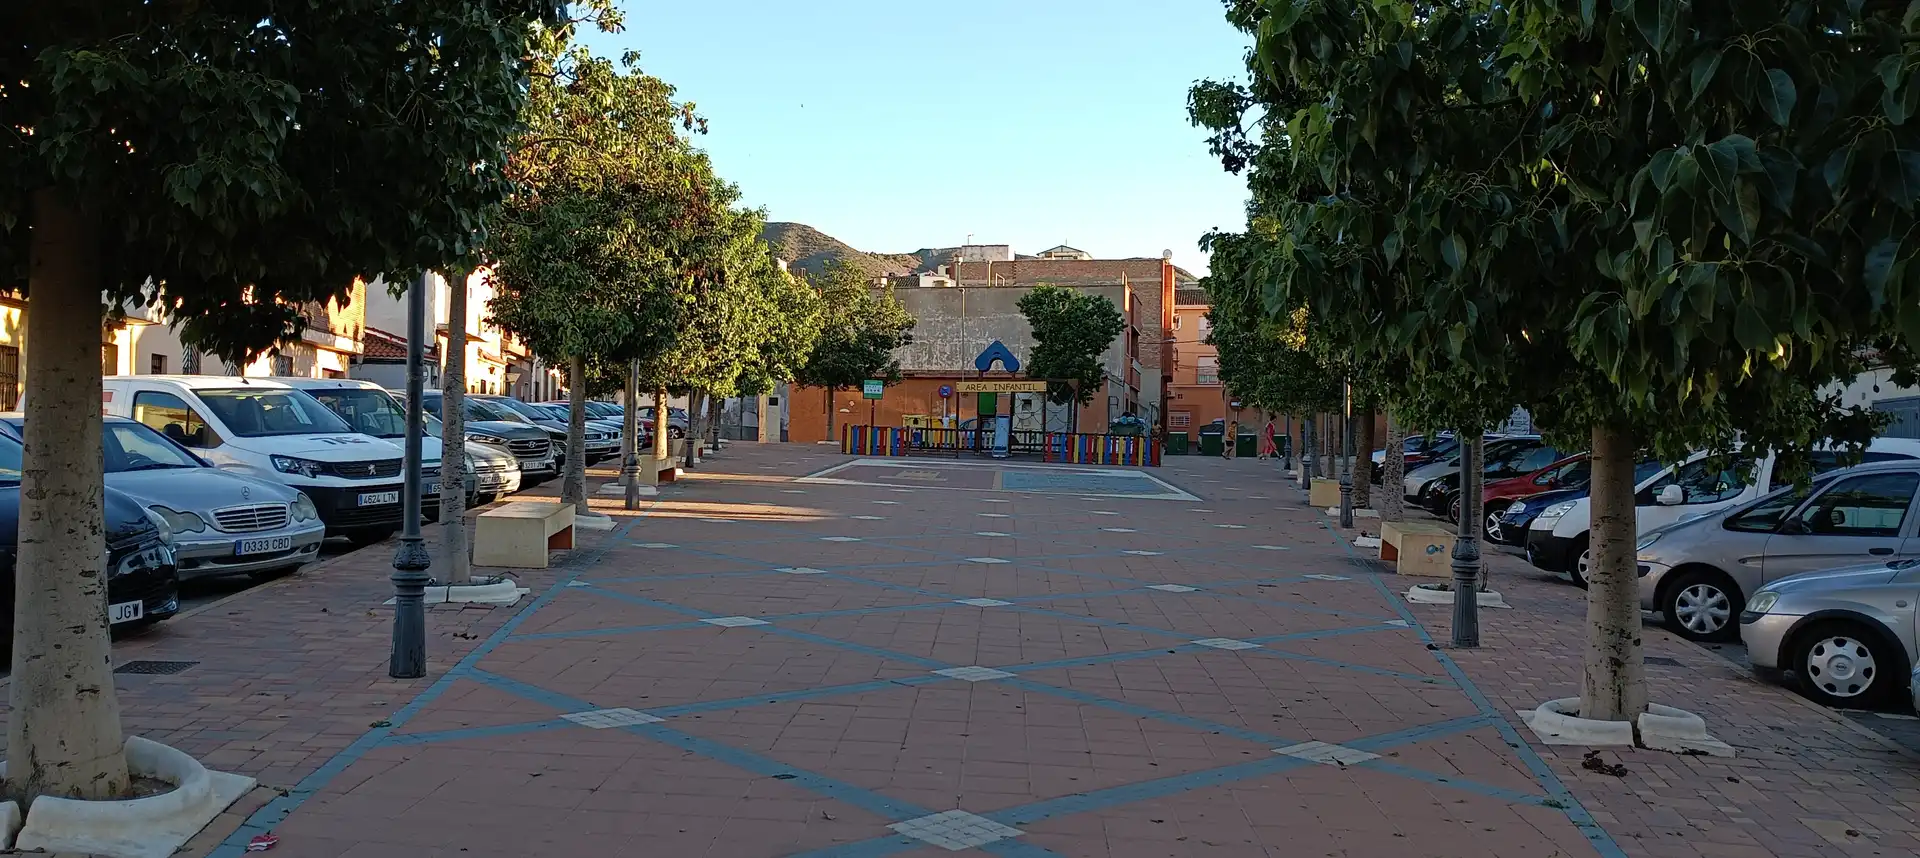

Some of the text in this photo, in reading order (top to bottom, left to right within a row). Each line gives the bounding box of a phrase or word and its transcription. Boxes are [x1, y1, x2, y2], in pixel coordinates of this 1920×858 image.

[965, 383, 1038, 391] AREA INFANTIL
[363, 492, 397, 504] 4624 LTN
[244, 537, 290, 552] 0333 CBD
[116, 603, 140, 620] JGW
